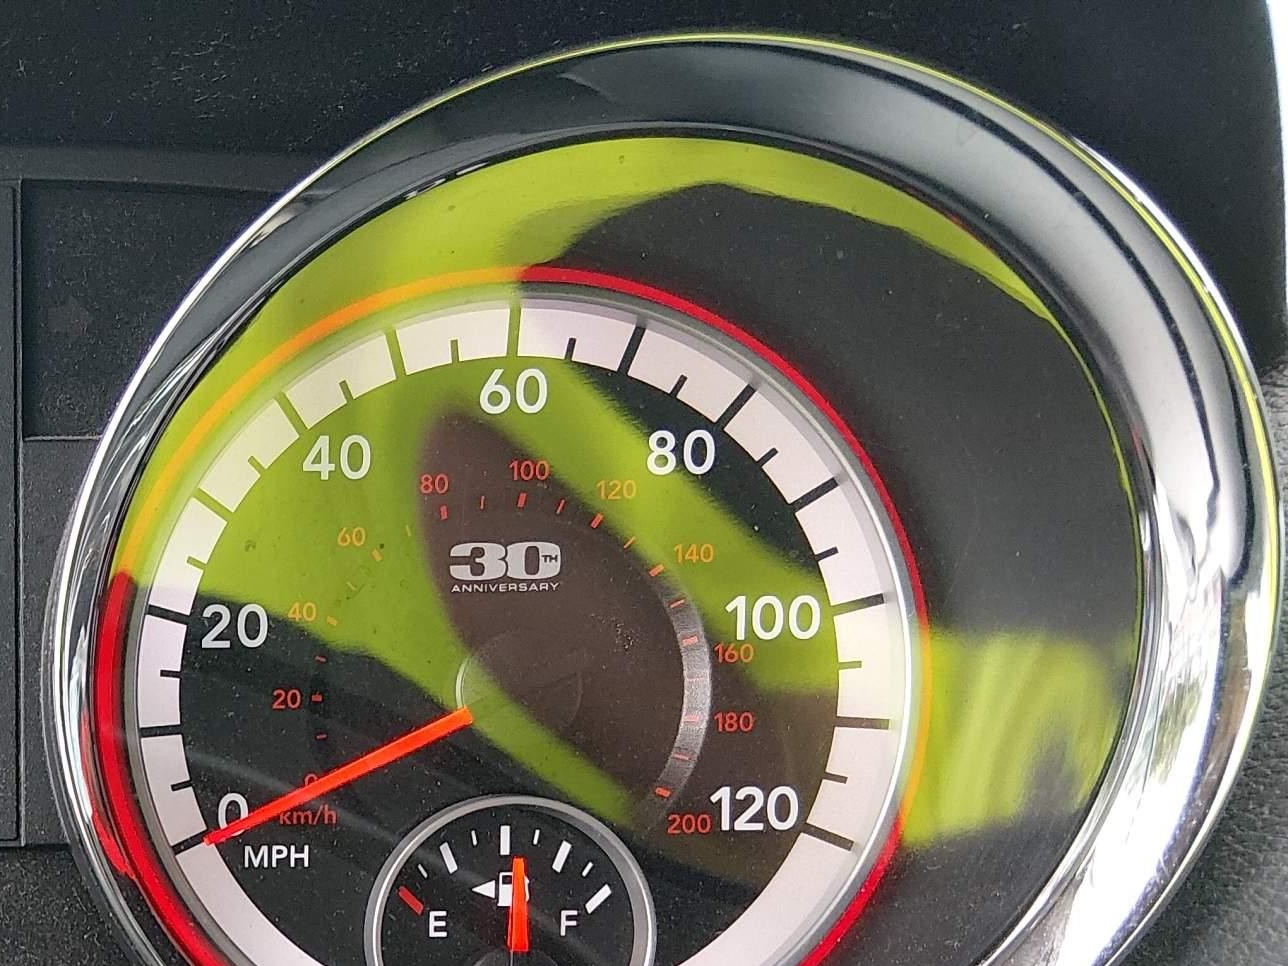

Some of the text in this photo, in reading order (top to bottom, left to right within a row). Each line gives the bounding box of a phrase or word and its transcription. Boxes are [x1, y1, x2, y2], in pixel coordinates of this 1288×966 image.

[479, 368, 548, 414] 60
[302, 434, 372, 480] 40
[646, 430, 716, 476] 80
[509, 459, 550, 482] 100
[420, 474, 449, 496] 80
[596, 479, 636, 501] 120
[336, 527, 366, 549] 60
[673, 543, 714, 565] 140
[451, 582, 560, 593] ANNIVERSARY
[287, 601, 317, 623] 40
[725, 595, 820, 641] 100
[201, 604, 268, 648] 20
[714, 642, 754, 663] 160
[272, 689, 301, 710] 20
[714, 711, 754, 733] 180
[218, 792, 249, 837] 0
[279, 804, 338, 825] km/h
[710, 785, 799, 832] 120
[668, 813, 710, 834] 200
[243, 845, 310, 869] MPH
[429, 912, 447, 938] E
[561, 912, 578, 938] F
